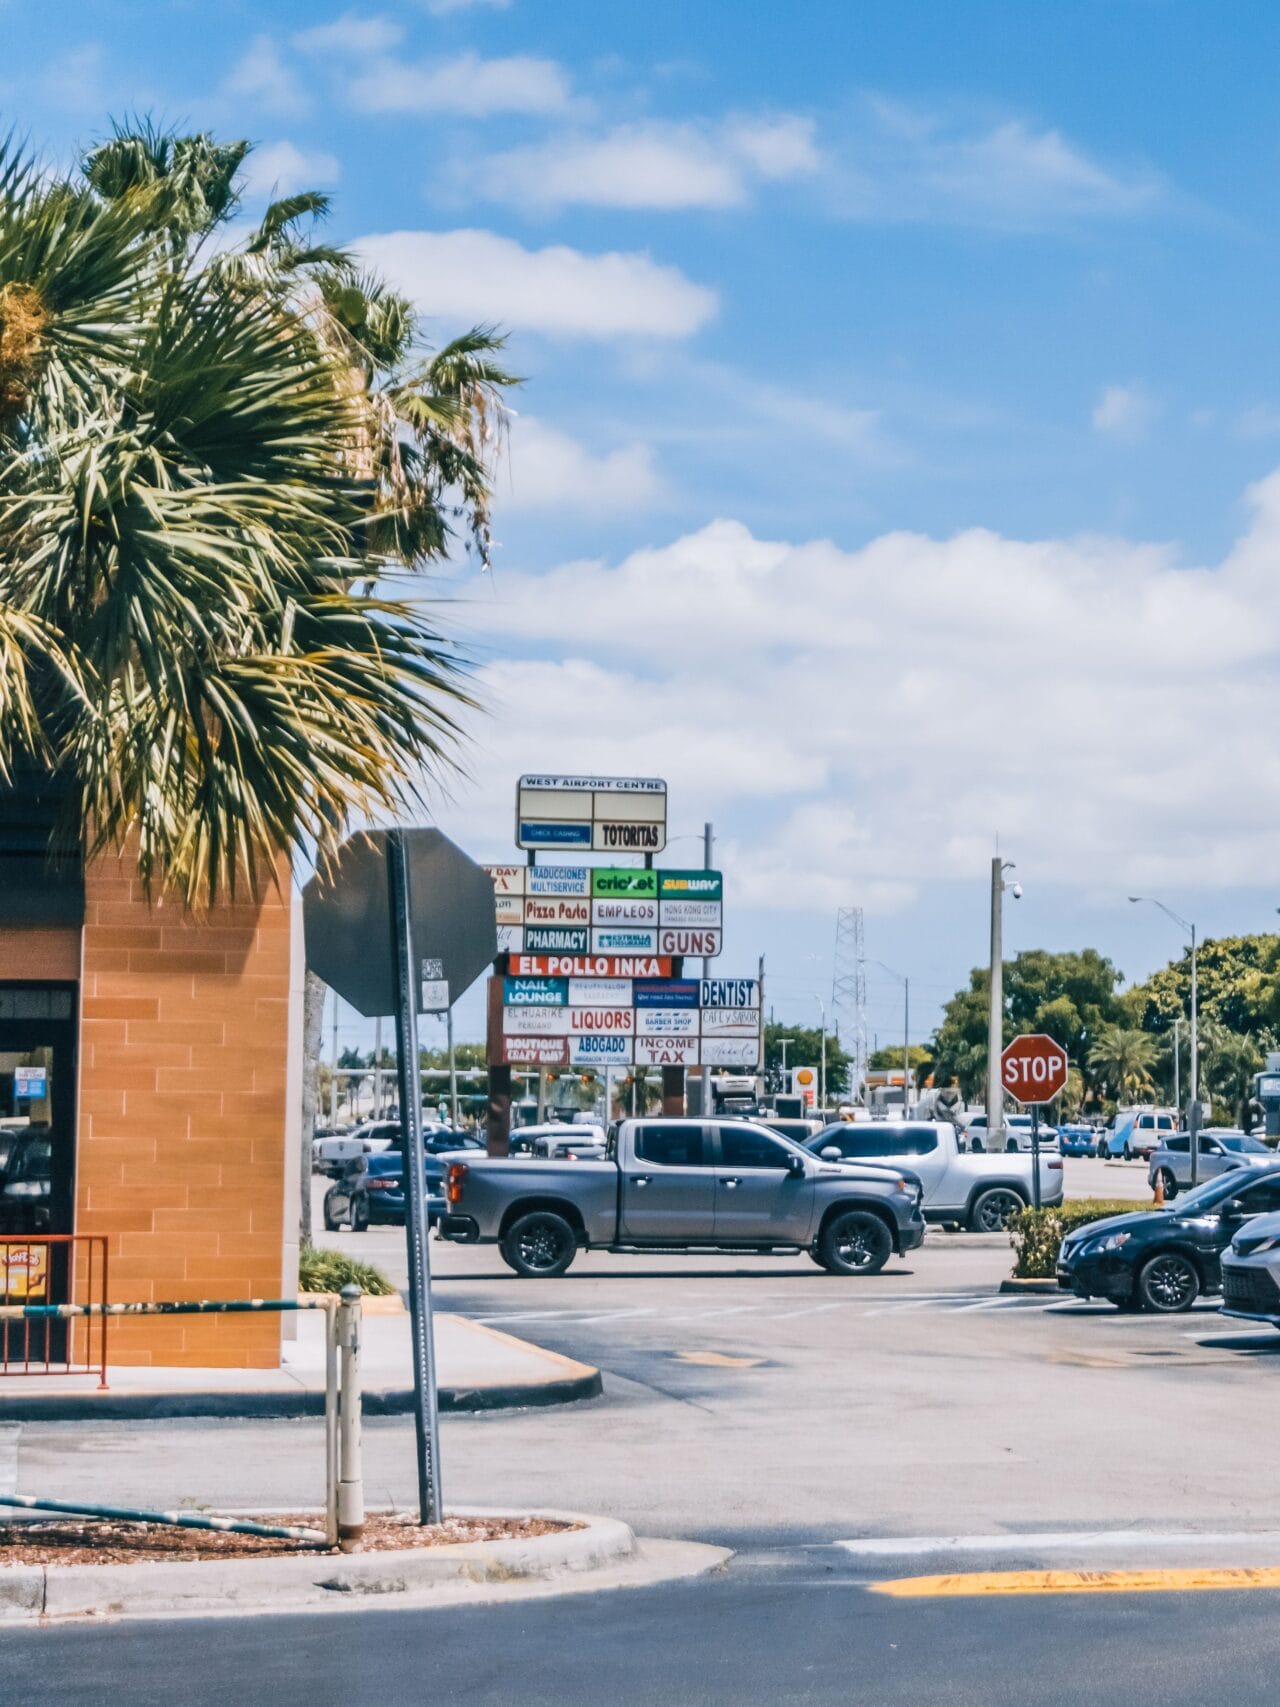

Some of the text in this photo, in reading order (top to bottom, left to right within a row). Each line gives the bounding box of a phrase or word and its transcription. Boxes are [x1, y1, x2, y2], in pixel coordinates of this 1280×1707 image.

[526, 777, 661, 790] WEST AIRPORT CENTRE
[602, 824, 659, 846] TOTORITAS
[496, 868, 518, 876] DAY
[528, 868, 587, 880] TRADUCCIONES
[530, 881, 585, 893] MULTISERVICE
[596, 876, 654, 890] cricket
[662, 879, 720, 890] SUBWAY
[526, 901, 555, 919] Pizza
[558, 902, 588, 919] Pasta
[597, 905, 654, 919] EMPLEOS
[664, 904, 718, 915] HONG KONG CITY
[527, 930, 586, 949] PHARMACY
[662, 931, 716, 954] GUNS
[519, 956, 661, 977] EL POLLO INKA
[514, 980, 548, 990] NAIL
[508, 991, 562, 1003] LOUNGE
[702, 981, 754, 1007] DENTIST
[507, 1008, 519, 1018] EL
[571, 1011, 632, 1030] LIQUORS
[505, 1037, 564, 1049] BOUTIQUE
[578, 1036, 626, 1052] ABOGADO
[640, 1038, 695, 1049] INCOME
[647, 1050, 685, 1063] TAX
[1004, 1055, 1063, 1083] STOP
